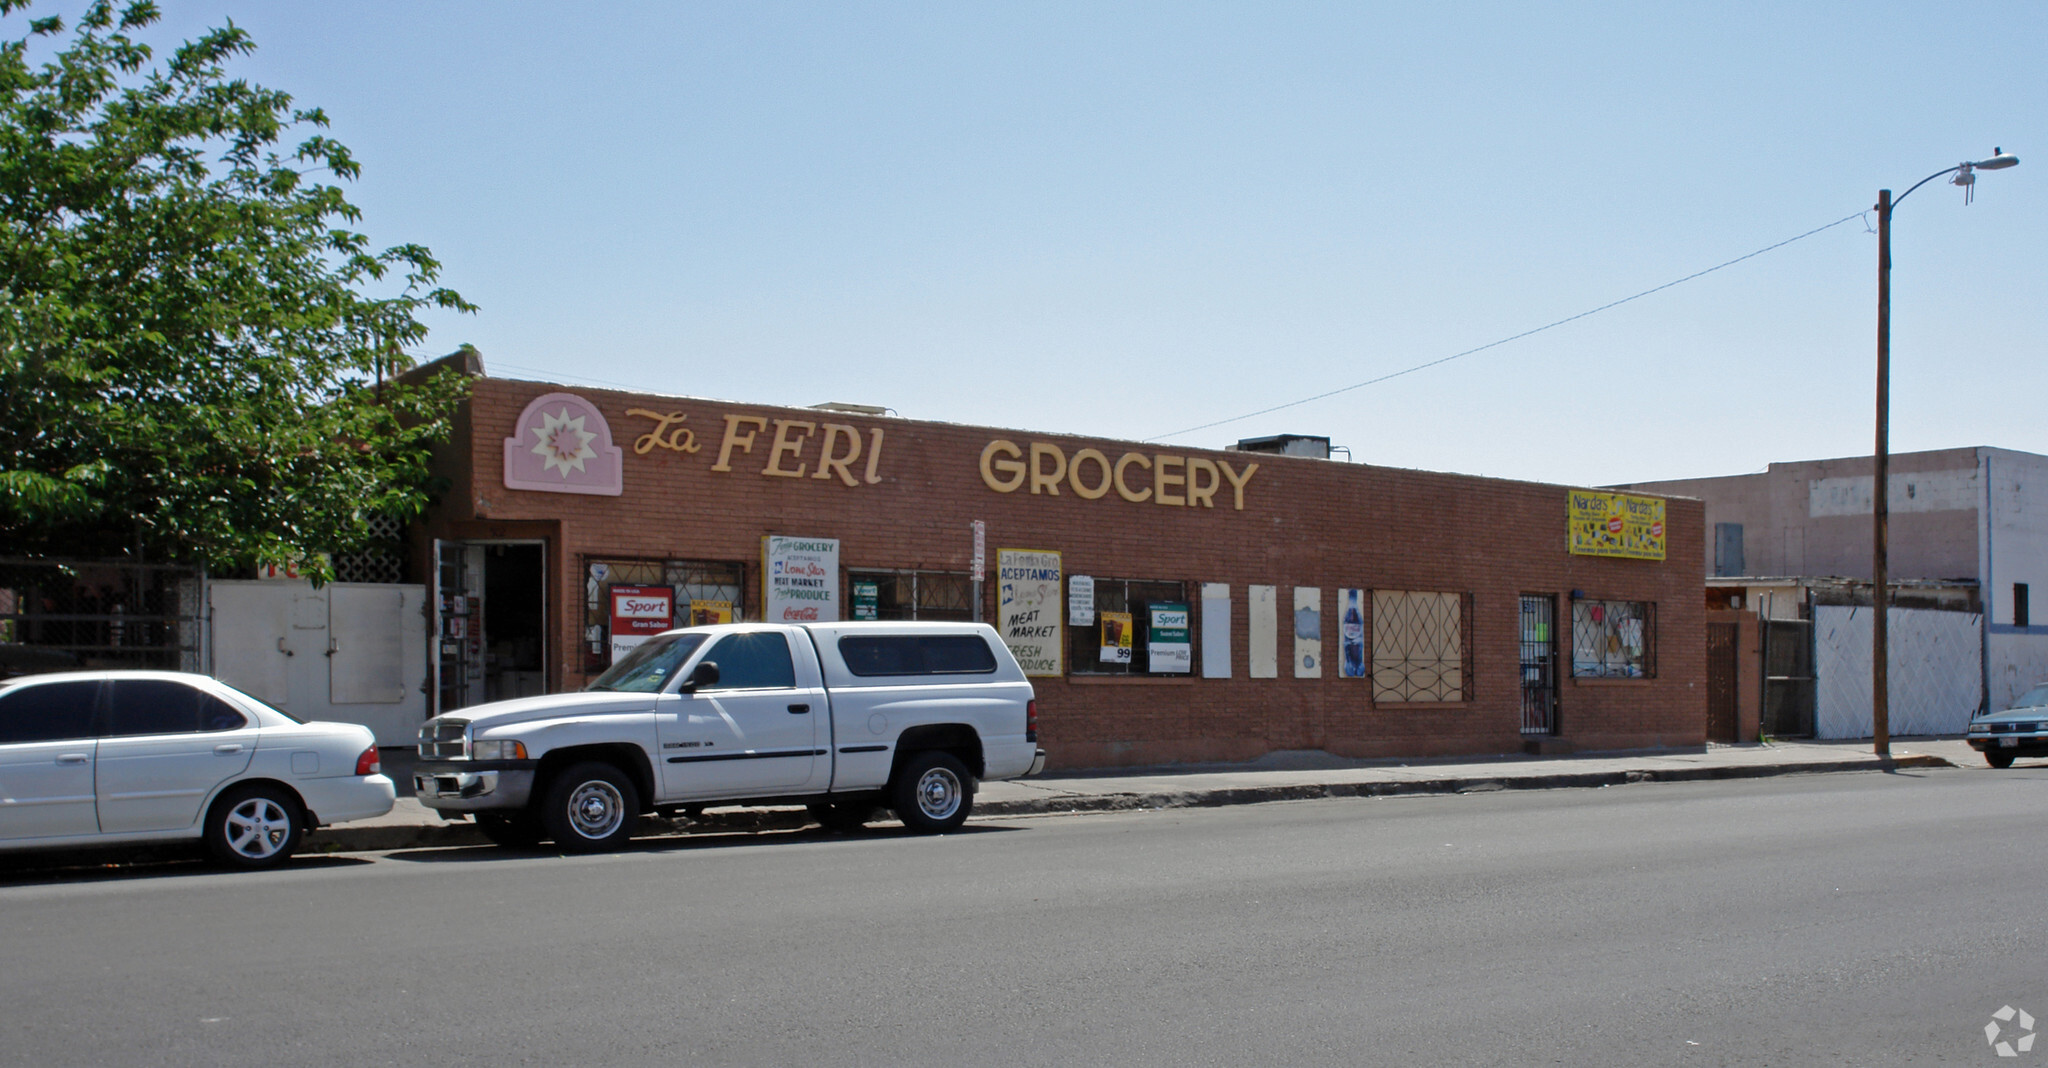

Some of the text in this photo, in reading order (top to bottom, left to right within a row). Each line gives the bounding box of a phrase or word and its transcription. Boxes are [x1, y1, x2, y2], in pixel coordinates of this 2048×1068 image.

[625, 408, 702, 455] La
[979, 439, 1260, 511] GROCERY
[793, 541, 834, 553] GROCERY
[784, 561, 826, 577] Lone Star
[1000, 568, 1060, 581] ACEPTAMOS
[774, 577, 824, 588] MEAT MARKET
[790, 589, 831, 601] PRODUCE
[624, 600, 666, 615] Sport
[632, 620, 649, 628] Gran
[1007, 609, 1040, 628] MEAT
[1157, 613, 1186, 626] Sport
[1008, 625, 1056, 638] MARKET
[1117, 648, 1131, 659] 99
[1150, 649, 1176, 657] Premium
[1018, 659, 1056, 671] ODUCE
